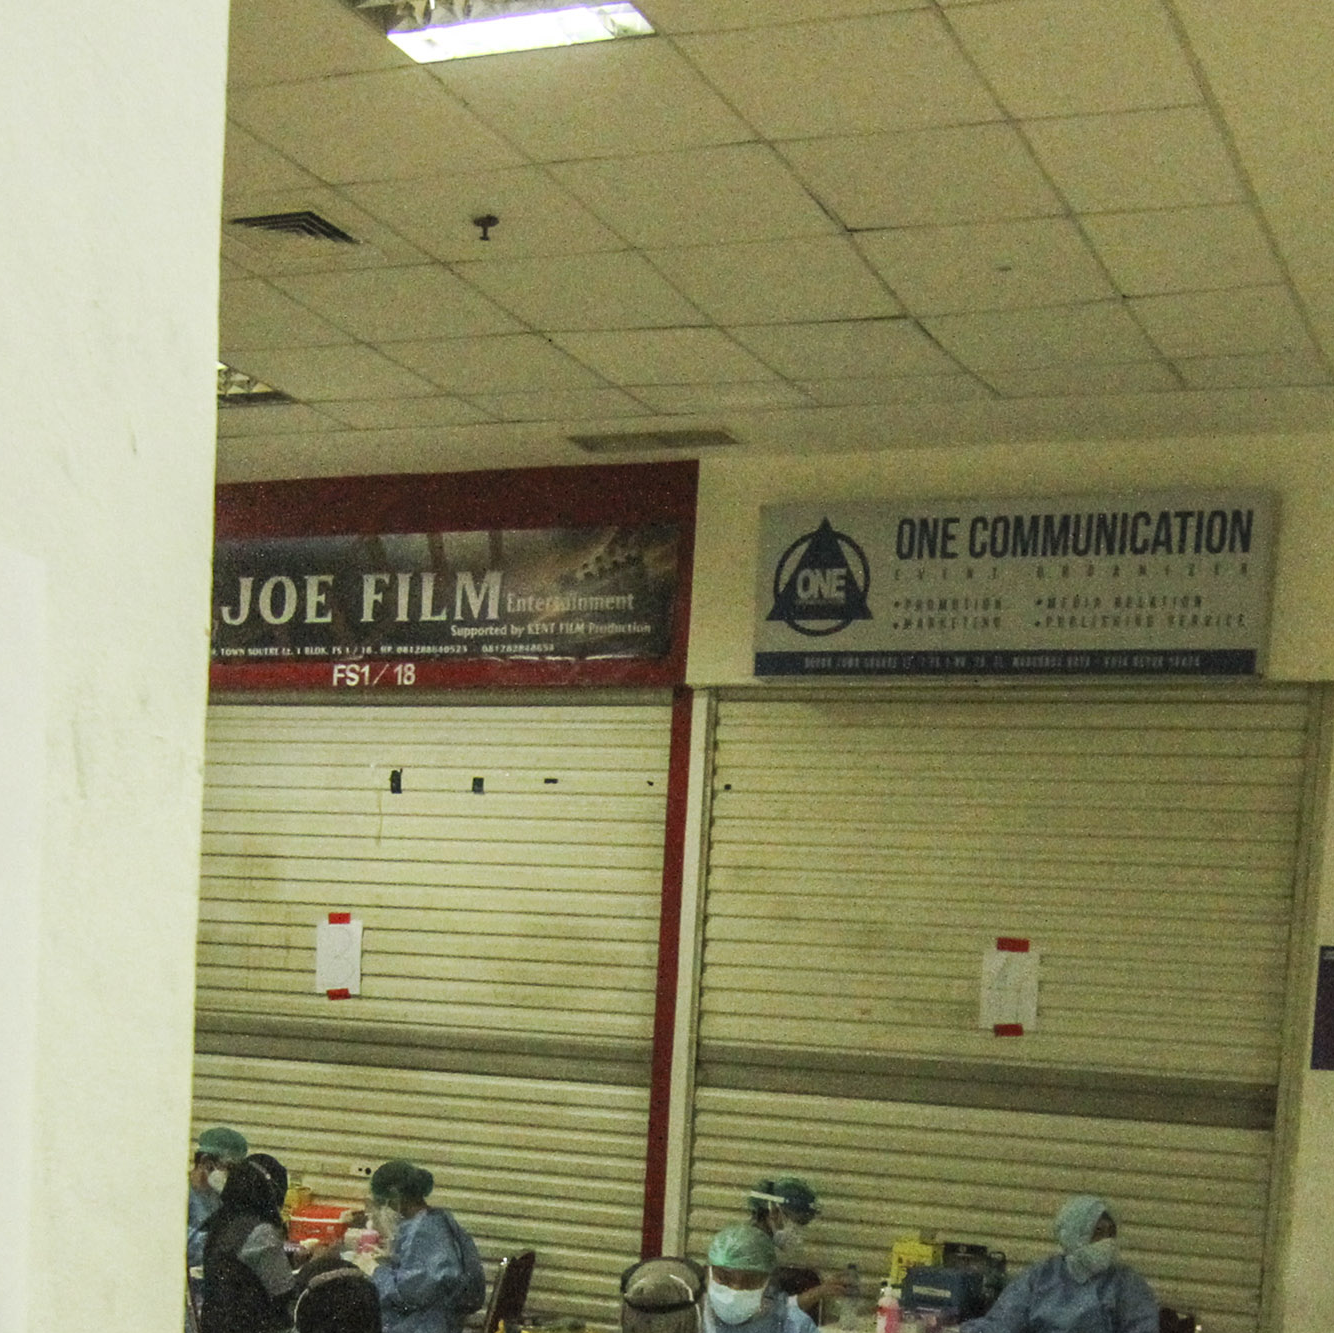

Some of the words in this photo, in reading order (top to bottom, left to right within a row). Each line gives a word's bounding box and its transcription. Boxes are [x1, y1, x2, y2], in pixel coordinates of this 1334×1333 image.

[895, 518, 960, 560] ONE
[968, 509, 1254, 559] COMMUNICATION
[221, 575, 335, 626] JOE
[360, 570, 505, 623] FILM
[796, 568, 848, 600] ONE
[451, 624, 508, 638] Supported
[510, 624, 526, 637] by
[527, 622, 556, 635] KENT
[559, 622, 586, 634] FILM
[588, 621, 652, 635] Production
